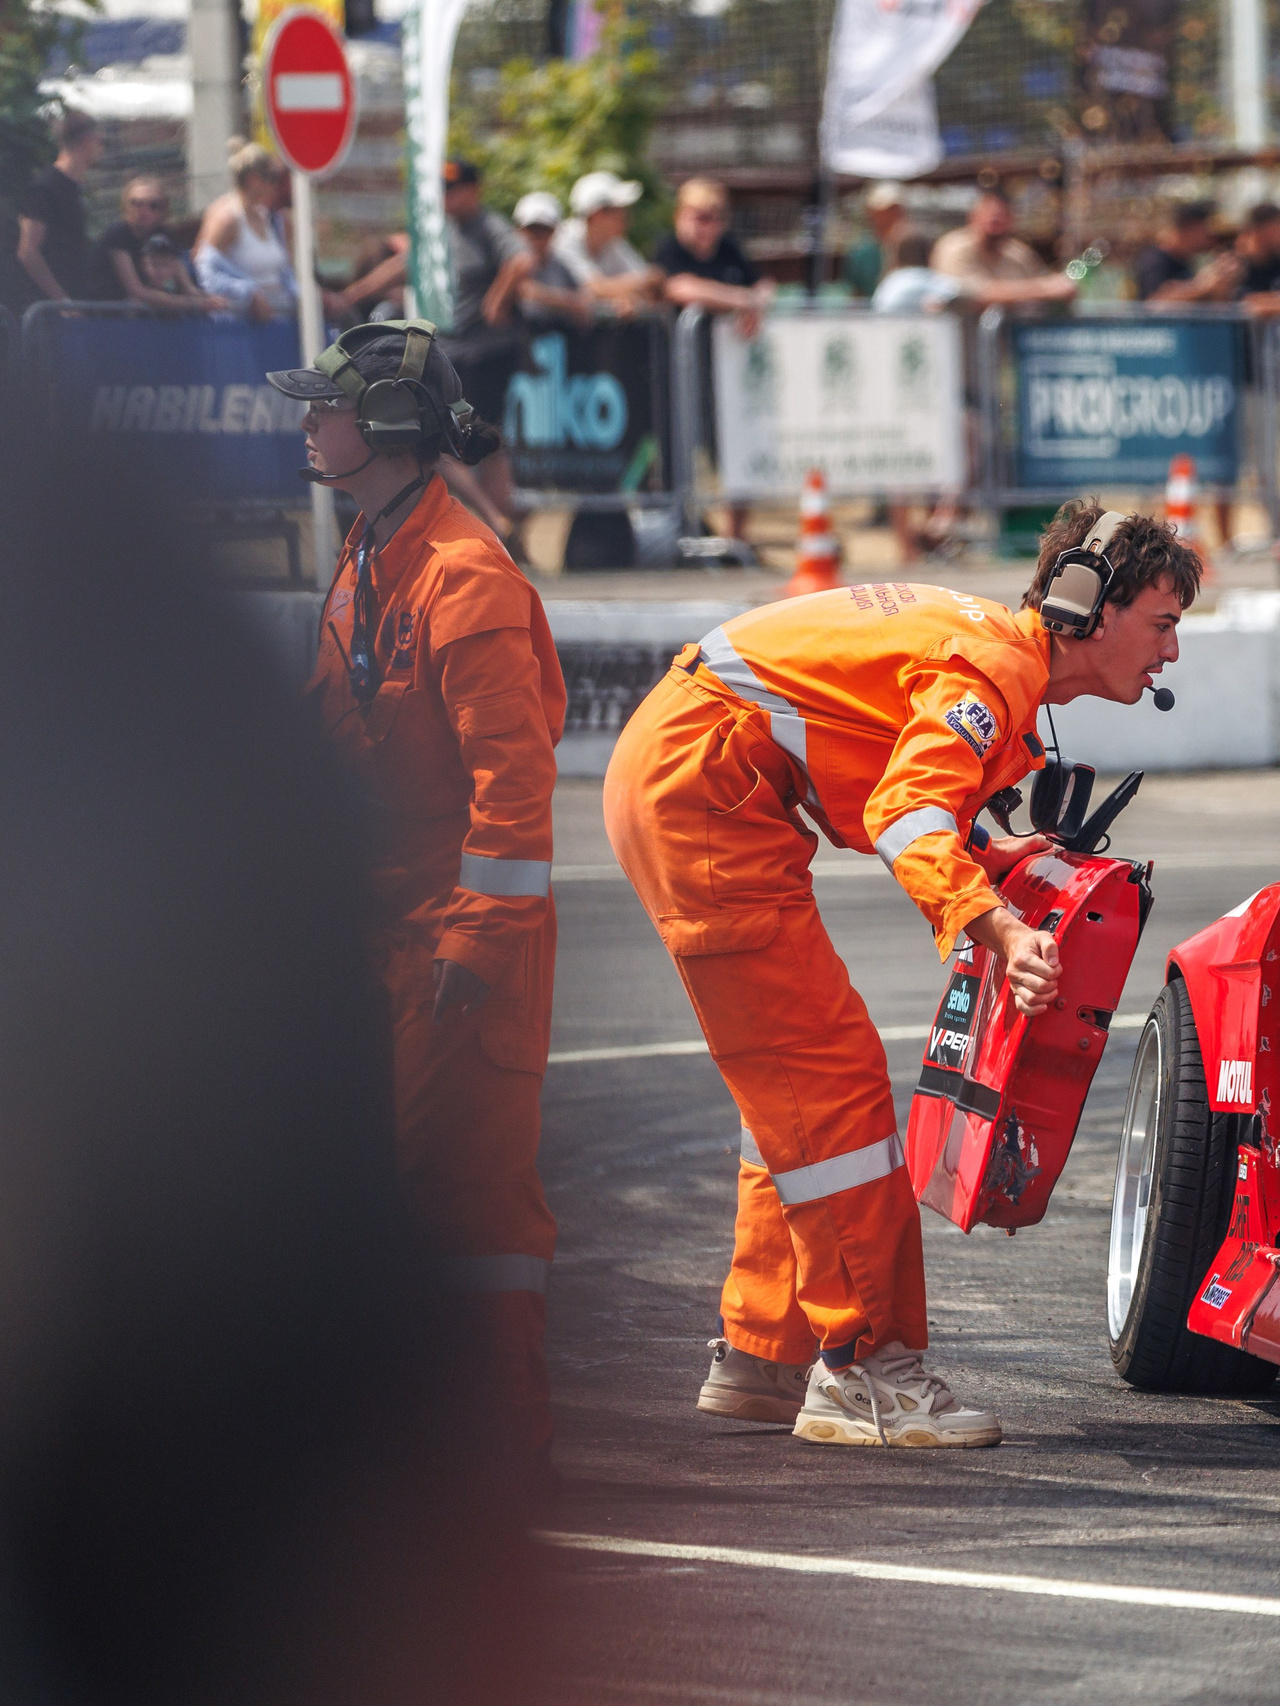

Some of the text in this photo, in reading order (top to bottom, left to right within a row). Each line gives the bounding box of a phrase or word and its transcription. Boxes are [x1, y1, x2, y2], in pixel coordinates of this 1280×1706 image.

[967, 703, 994, 738] FIA
[930, 1026, 973, 1060] VIPER
[1216, 1060, 1252, 1104] MOTUL
